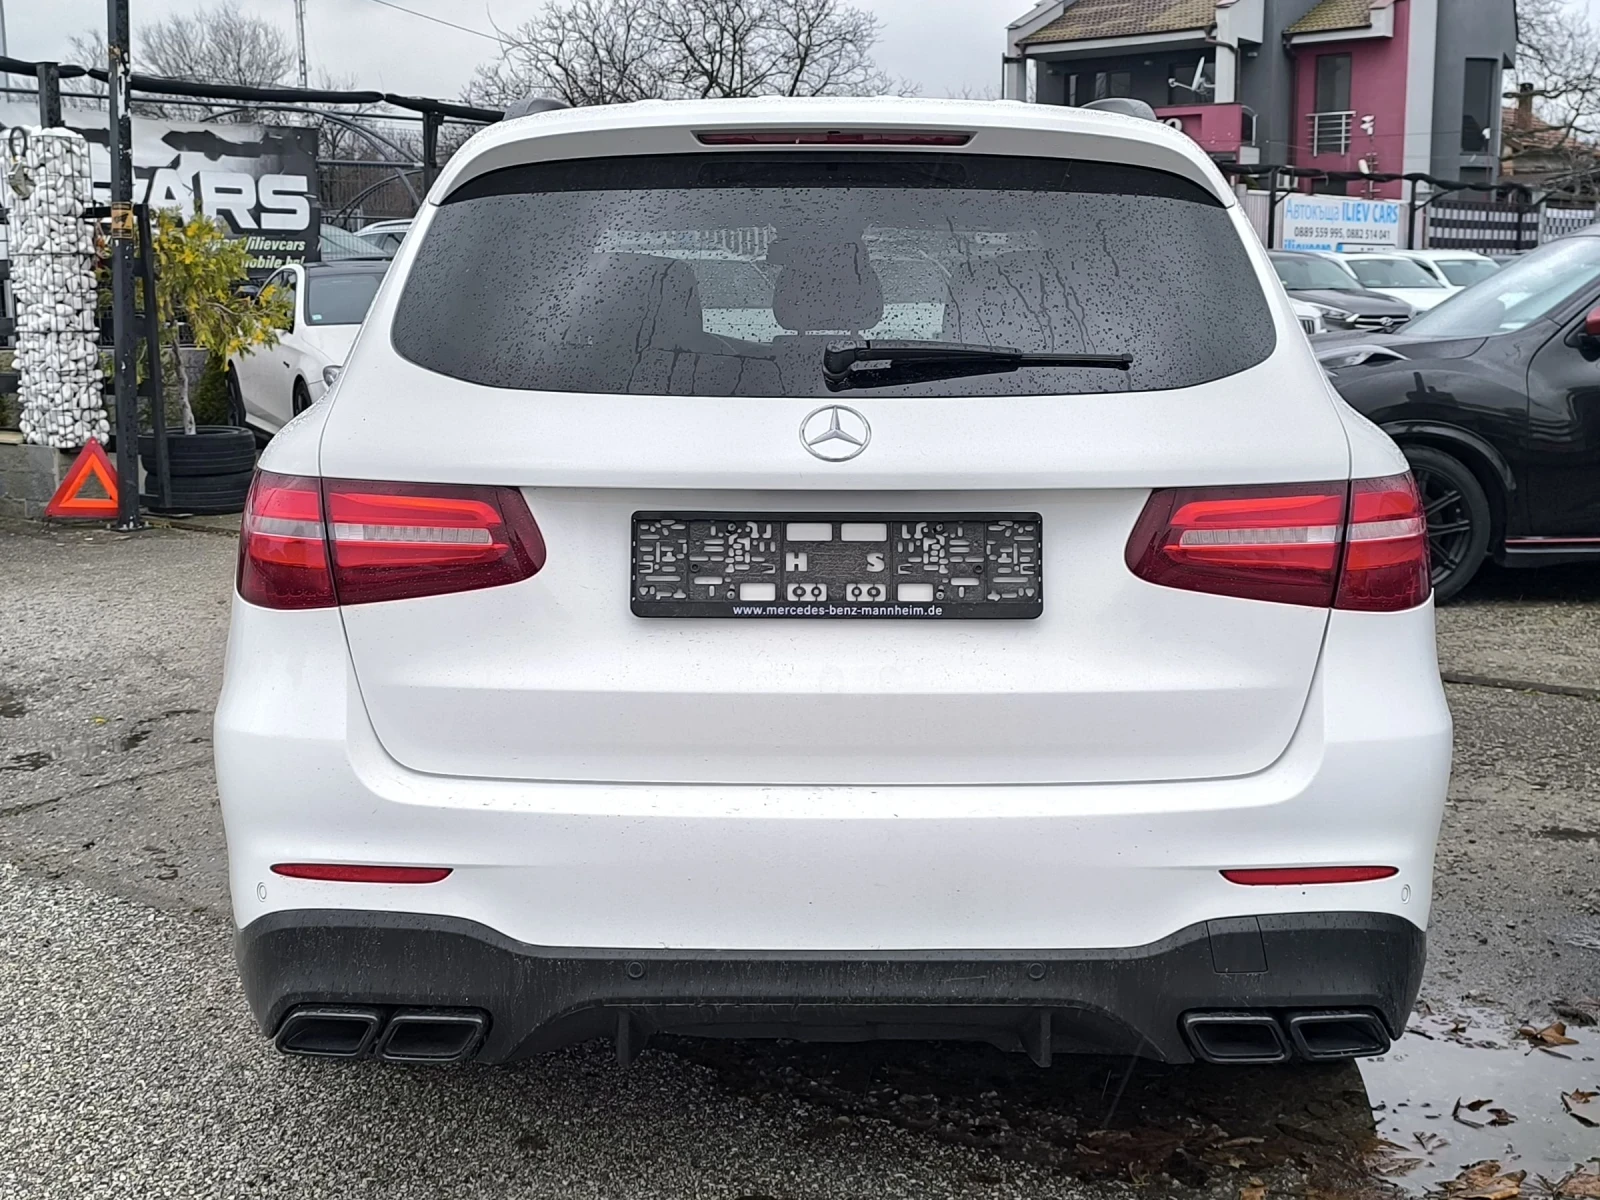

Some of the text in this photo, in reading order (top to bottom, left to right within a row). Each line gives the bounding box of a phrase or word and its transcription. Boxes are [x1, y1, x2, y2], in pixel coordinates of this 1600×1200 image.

[1342, 202, 1370, 222] ILIEV
[1373, 204, 1398, 223] CARS
[1294, 226, 1314, 238] 0889
[1315, 227, 1328, 238] 559
[1346, 228, 1364, 239] 0882
[1365, 229, 1378, 240] 514
[1379, 230, 1391, 240] 041
[732, 604, 943, 616] www.mercedes-benz-mannheim.de
